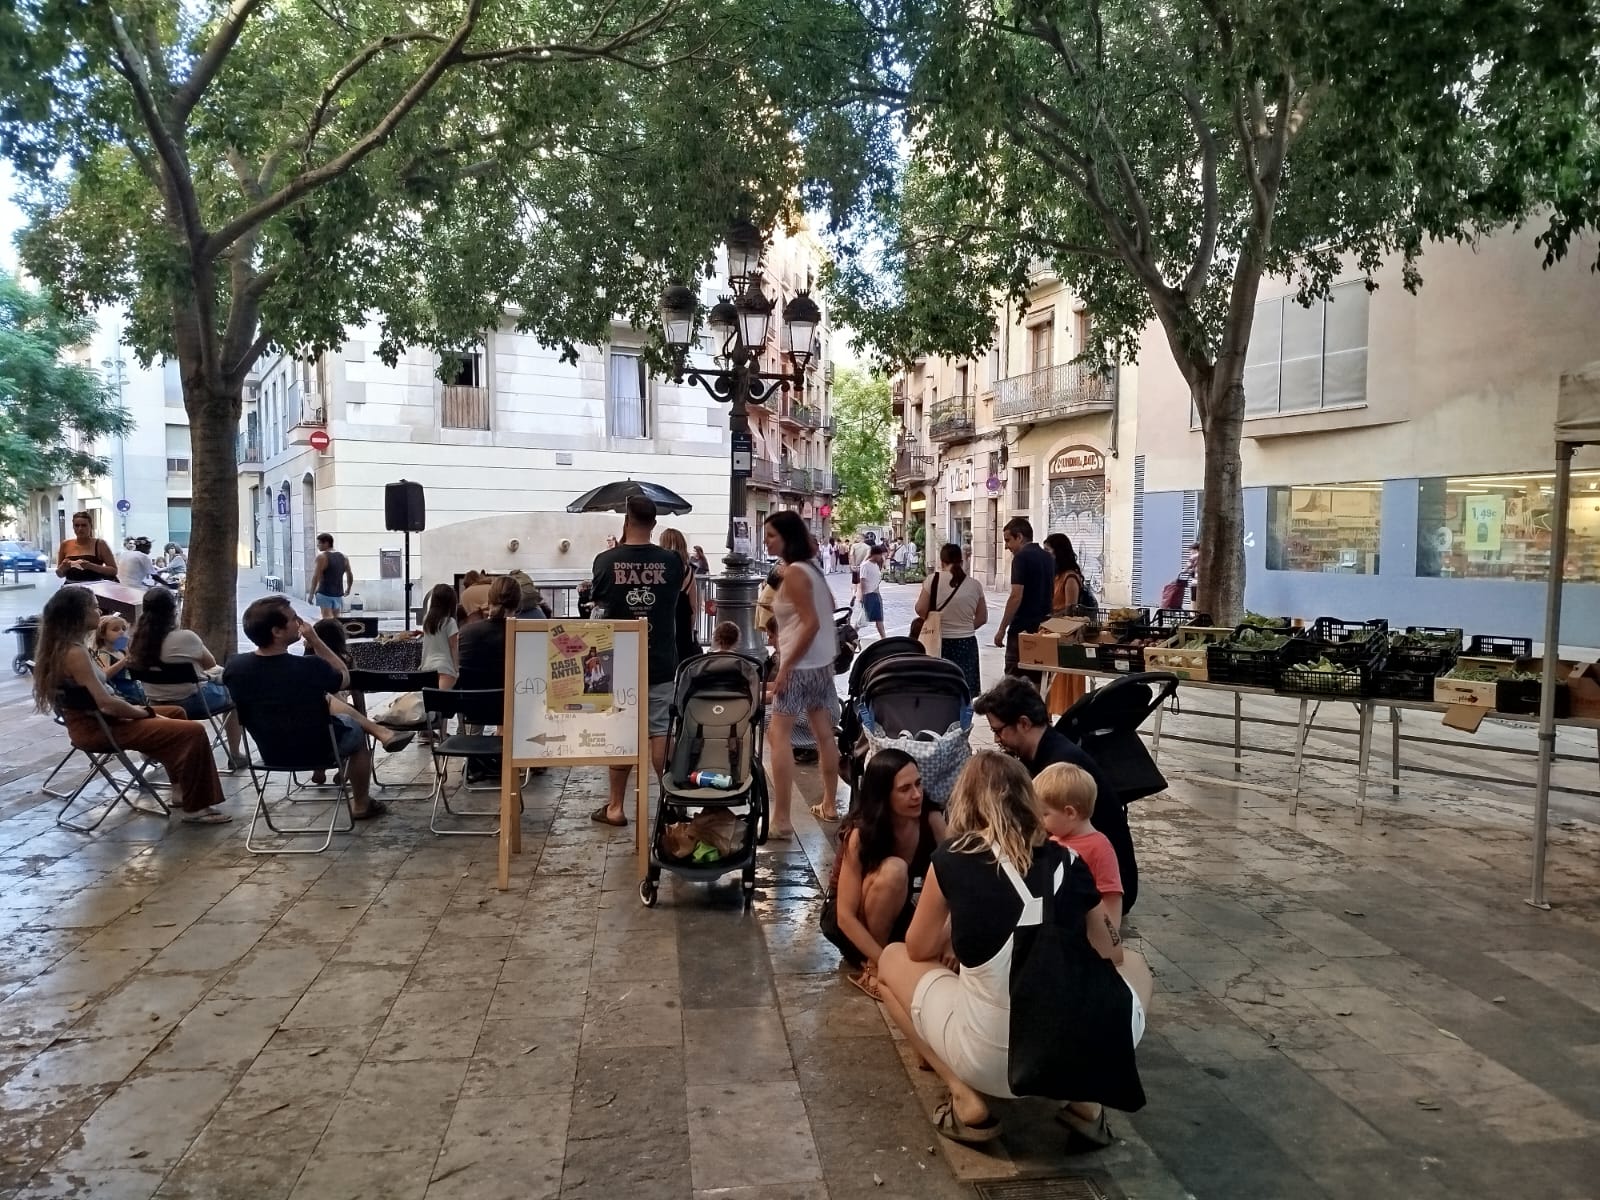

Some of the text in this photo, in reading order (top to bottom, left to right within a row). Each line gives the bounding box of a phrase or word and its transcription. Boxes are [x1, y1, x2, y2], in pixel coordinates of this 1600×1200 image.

[613, 562, 667, 570] DON'T LOOK
[614, 570, 667, 584] BACK
[551, 665, 582, 680] ANTIC
